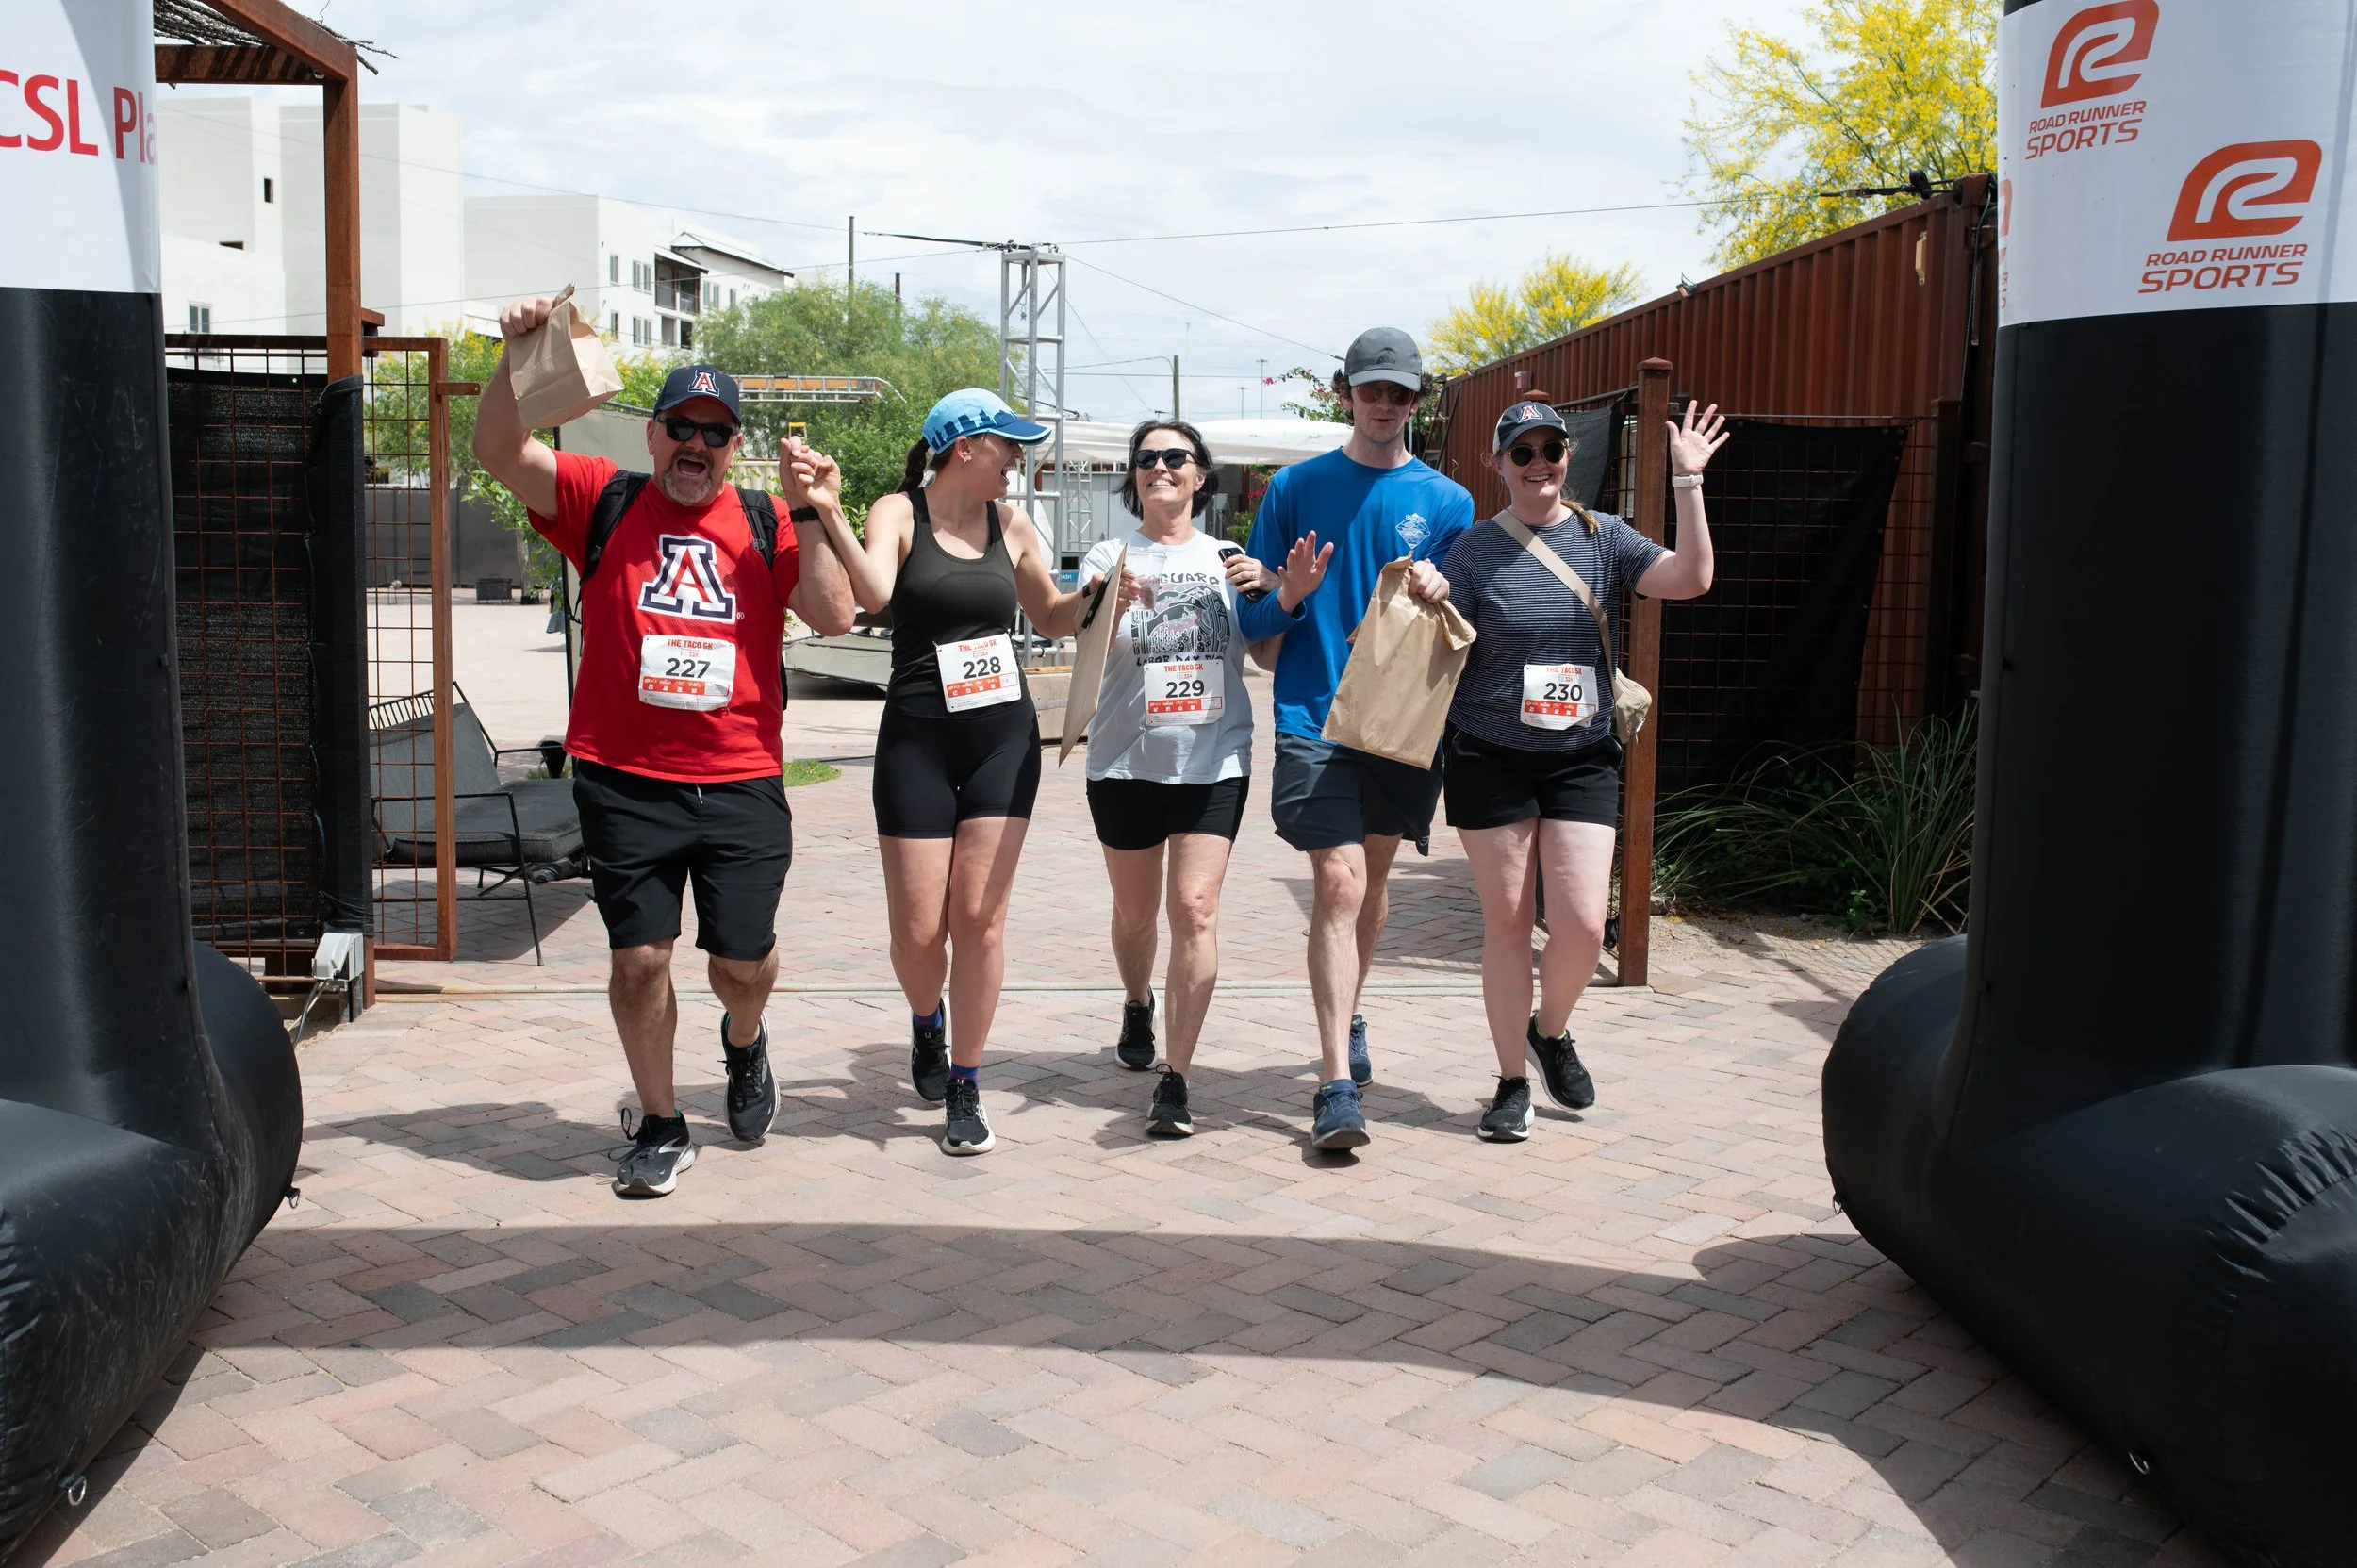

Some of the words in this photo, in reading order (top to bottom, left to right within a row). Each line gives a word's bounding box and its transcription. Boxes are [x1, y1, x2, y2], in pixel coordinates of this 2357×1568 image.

[2029, 114, 2066, 135] ROAD
[2068, 100, 2147, 125] RUNNER
[2025, 118, 2143, 160] SPORTS
[2145, 250, 2207, 267] ROAD
[2210, 243, 2308, 262] RUNNER
[2137, 261, 2303, 294] SPORTS
[687, 370, 720, 397] A
[1517, 404, 1543, 423] A
[637, 534, 736, 625] A
[1137, 572, 1220, 585] GUARO
[667, 638, 682, 648] THE
[684, 640, 701, 649] TACO
[702, 642, 714, 651] 5K
[958, 644, 972, 652] THE
[665, 657, 711, 679] 227
[963, 656, 1002, 680] 228
[1165, 679, 1205, 699] 229
[1543, 682, 1583, 702] 230
